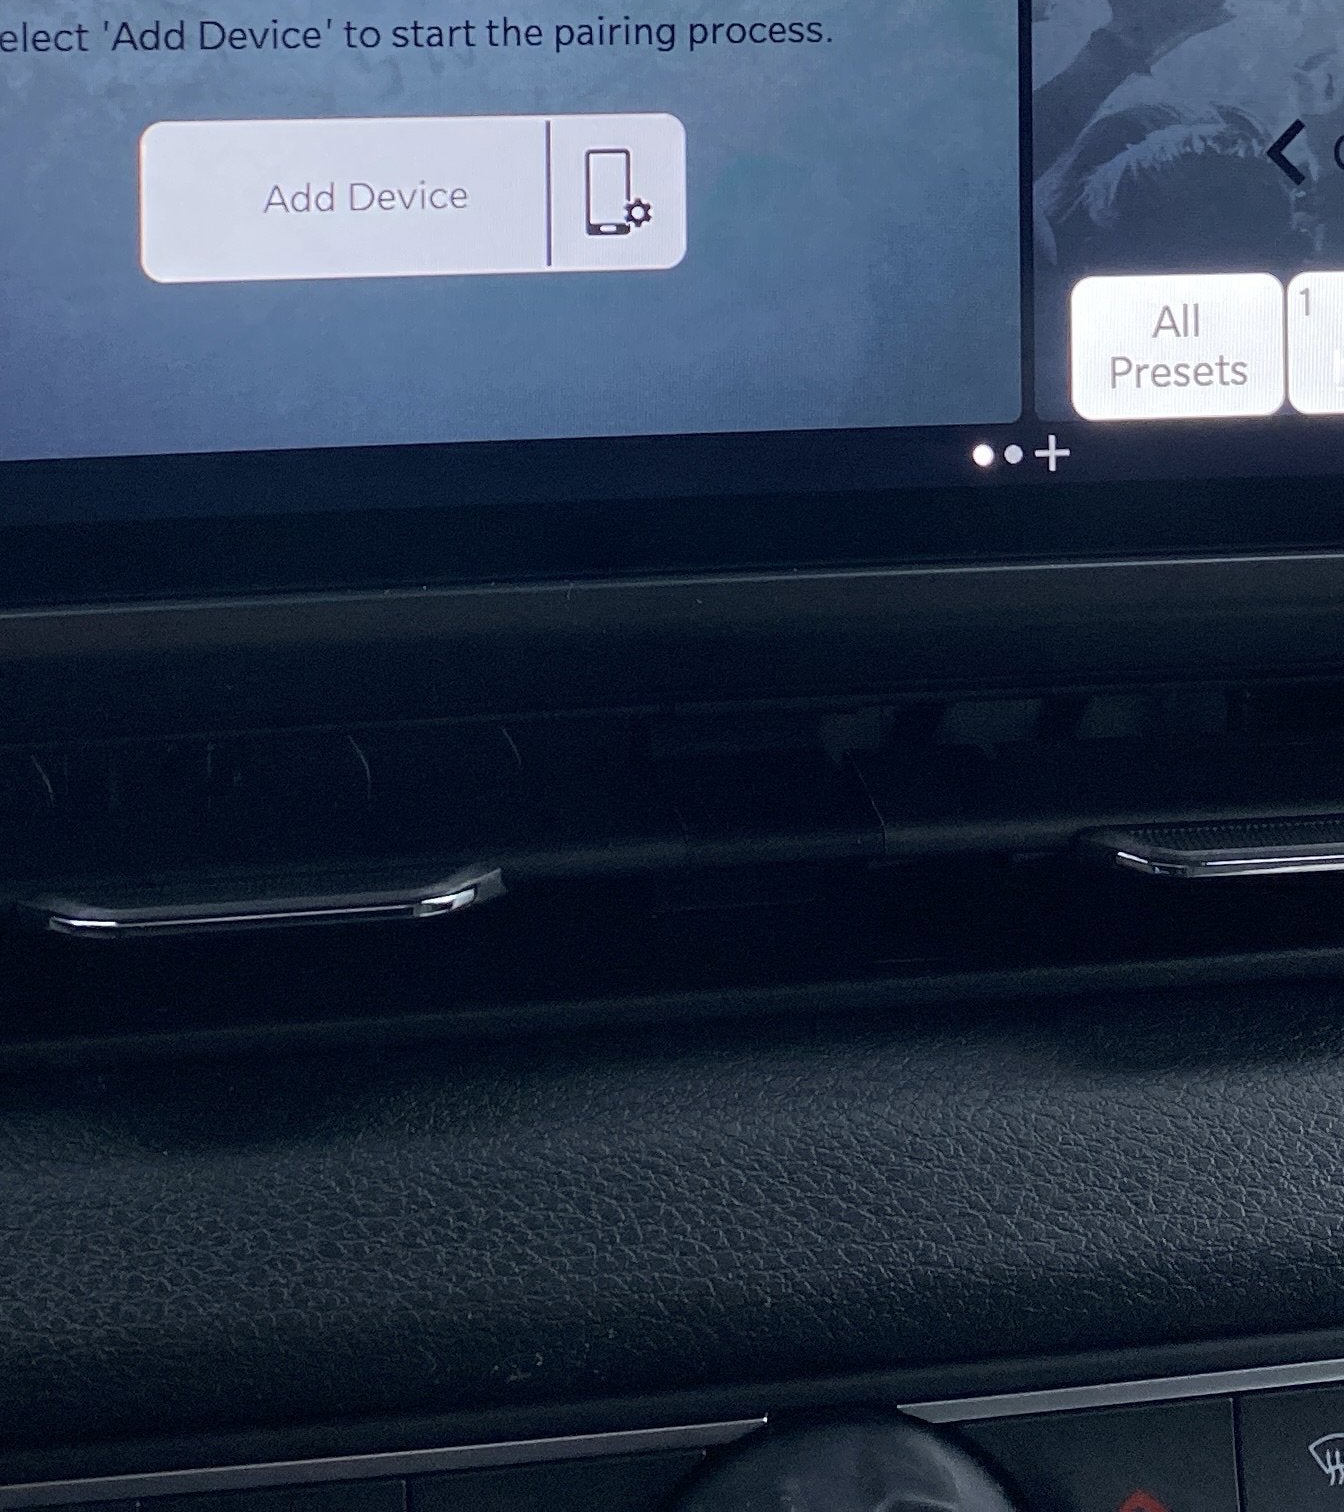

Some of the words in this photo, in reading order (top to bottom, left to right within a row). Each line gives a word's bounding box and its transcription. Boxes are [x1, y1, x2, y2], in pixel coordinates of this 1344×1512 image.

[103, 20, 187, 53] 'Add
[199, 18, 332, 52] Device'
[344, 20, 383, 50] to
[392, 19, 476, 49] start
[485, 17, 544, 49] the
[553, 17, 678, 54] pairing
[687, 18, 834, 53] process.
[262, 181, 336, 214] Add
[349, 180, 469, 212] Device
[1298, 286, 1312, 317] 1
[1151, 302, 1201, 339] All
[1110, 353, 1249, 390] Presets
